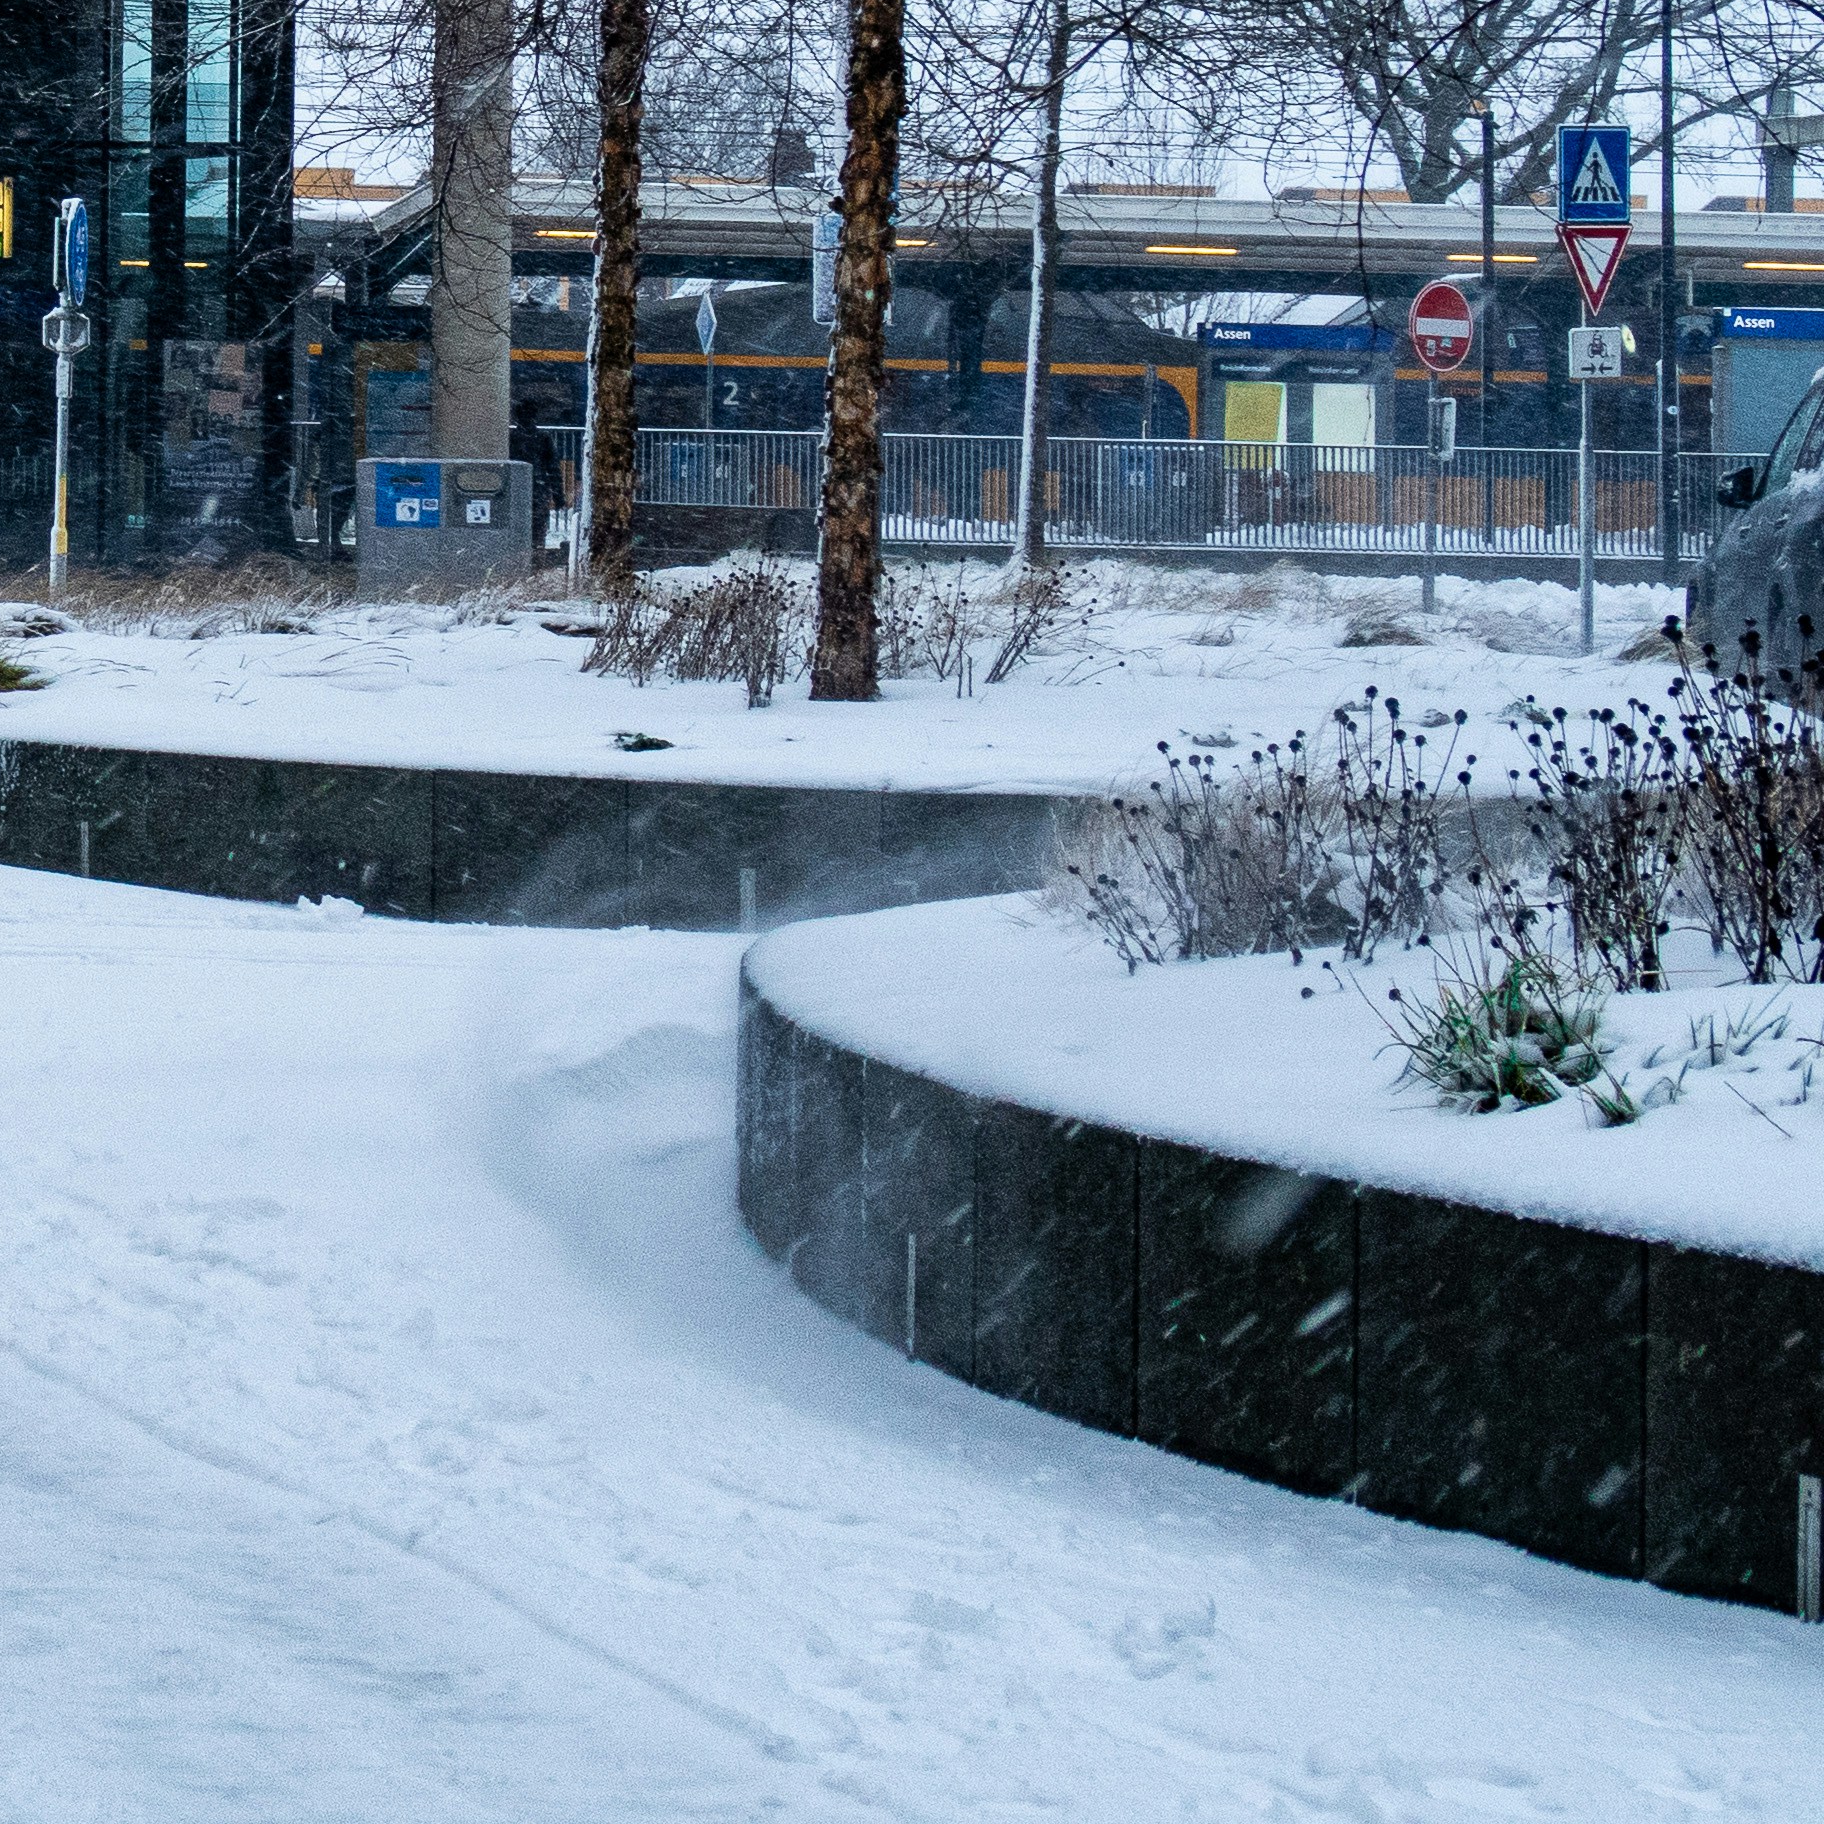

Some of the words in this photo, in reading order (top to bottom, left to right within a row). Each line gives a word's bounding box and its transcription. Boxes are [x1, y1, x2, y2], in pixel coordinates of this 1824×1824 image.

[1733, 315, 1775, 329] Assen
[1214, 328, 1252, 340] Assen
[723, 380, 740, 406] 2
